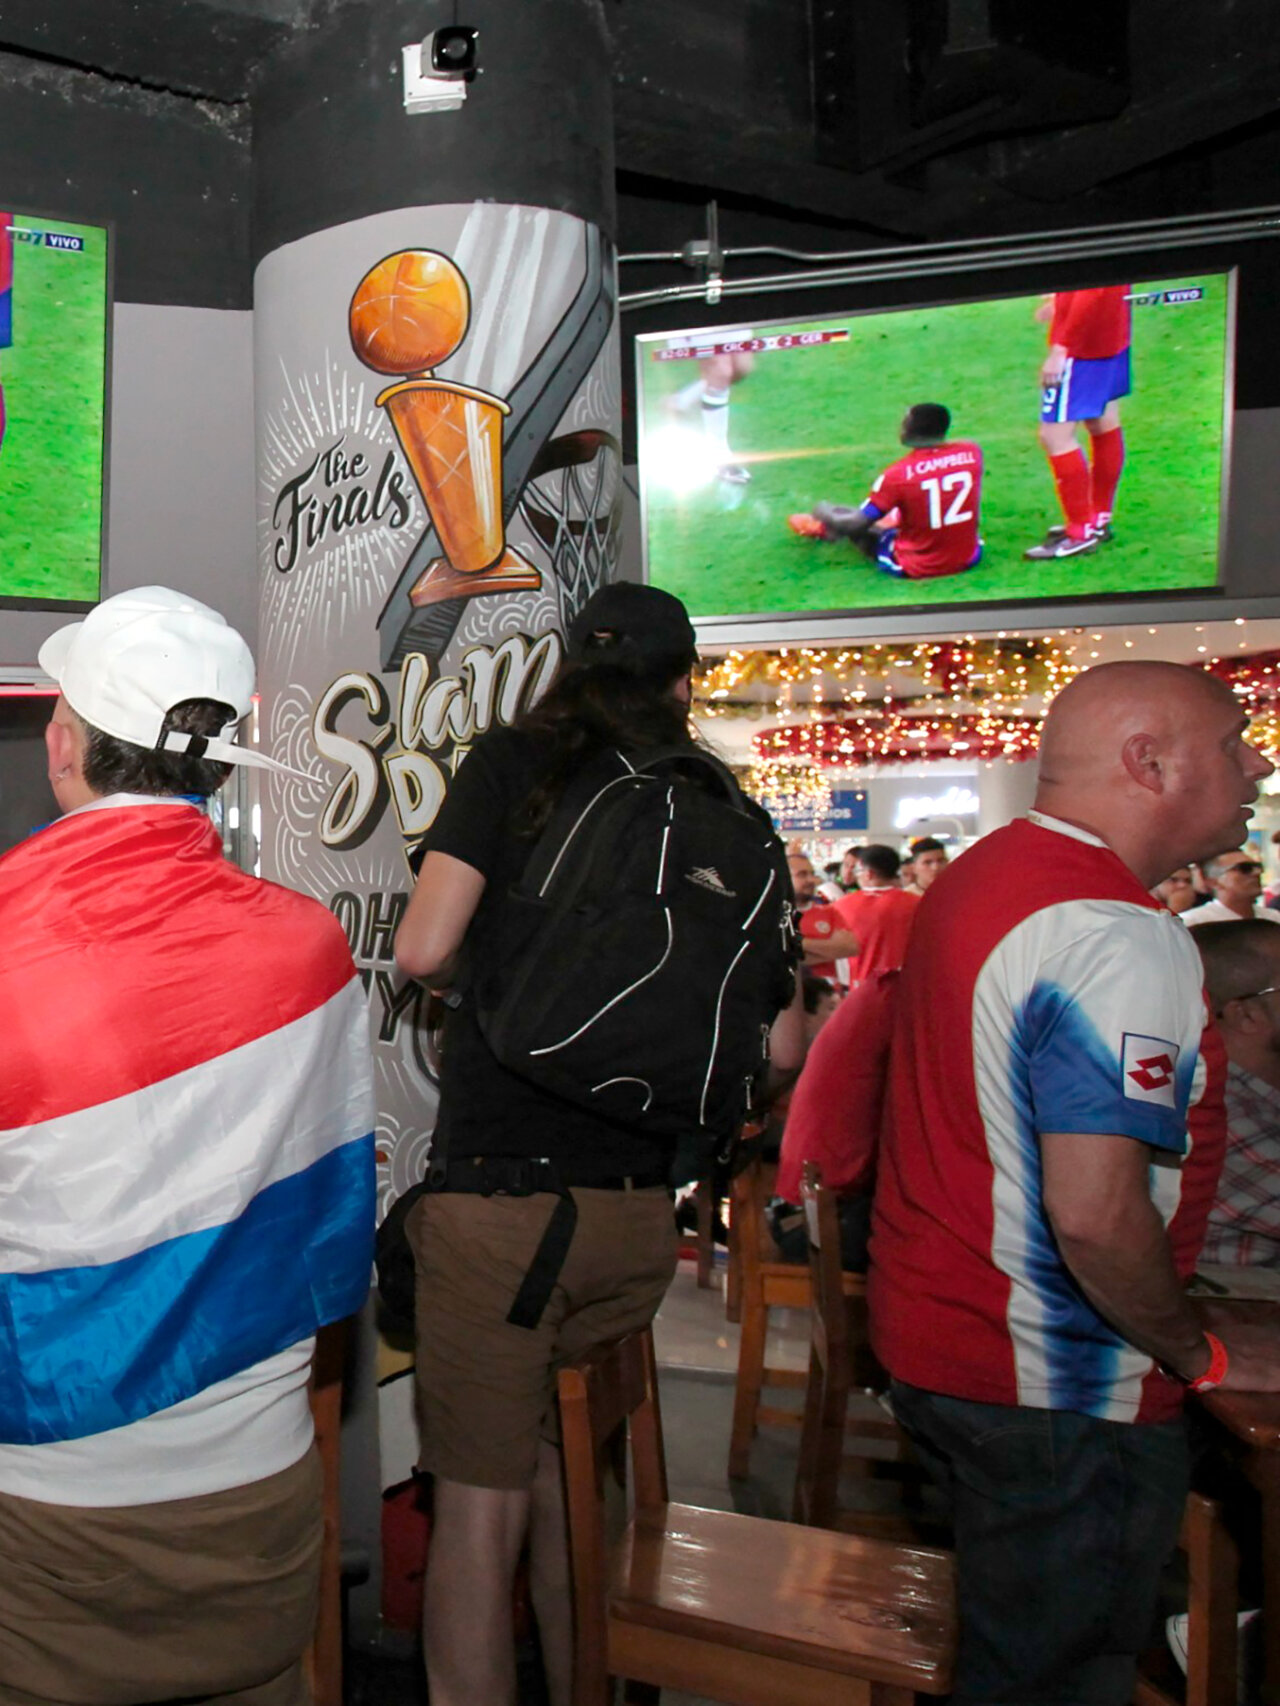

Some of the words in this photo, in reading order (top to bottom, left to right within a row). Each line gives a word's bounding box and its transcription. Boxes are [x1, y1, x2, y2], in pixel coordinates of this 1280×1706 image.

[49, 234, 81, 250] VIVO
[1167, 289, 1201, 301] VIVO
[324, 435, 370, 487] The
[915, 451, 976, 475] CAMPBELL
[273, 449, 413, 574] Finals
[920, 470, 974, 530] 12
[312, 628, 563, 848] Slam
[358, 967, 422, 1046] Y
